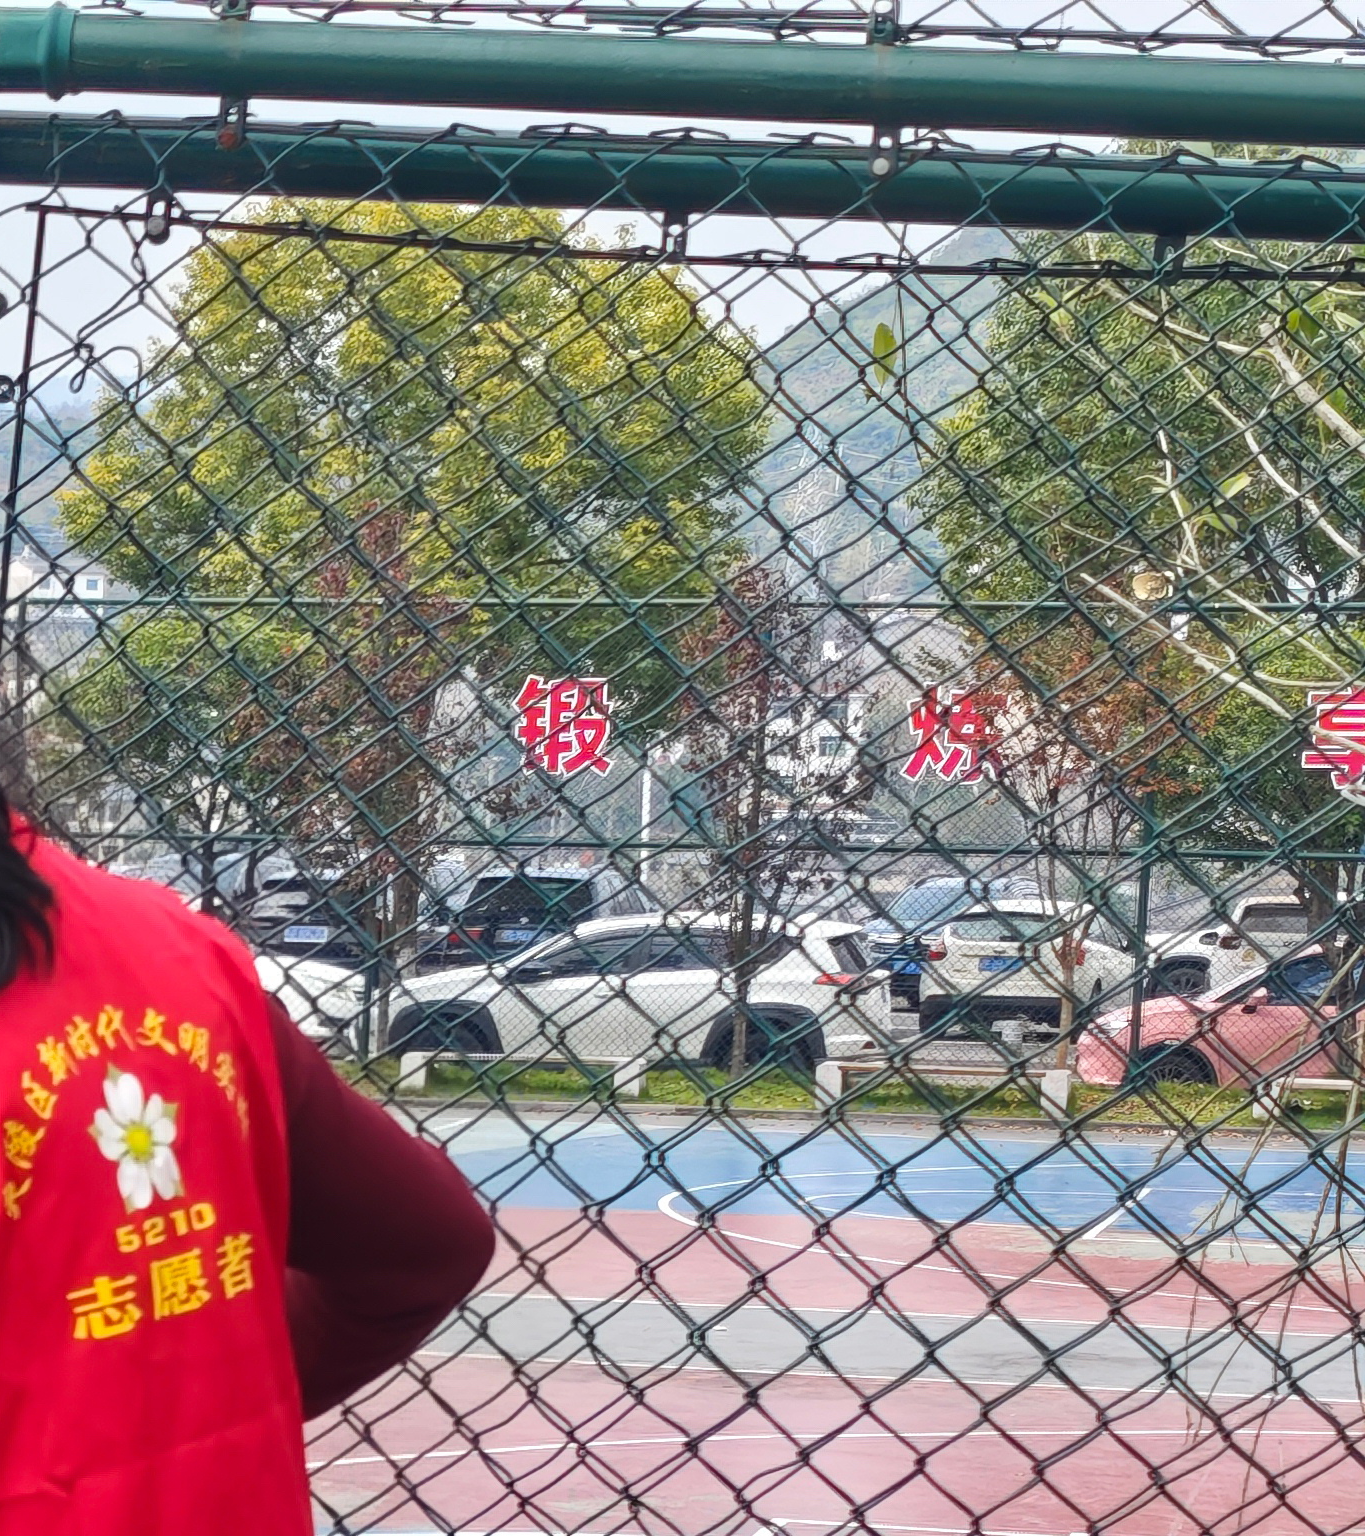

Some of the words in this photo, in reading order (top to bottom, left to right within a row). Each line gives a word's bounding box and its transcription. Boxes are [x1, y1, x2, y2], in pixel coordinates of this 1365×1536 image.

[115, 1202, 217, 1253] 5210
[66, 1232, 255, 1340] 志愿者
